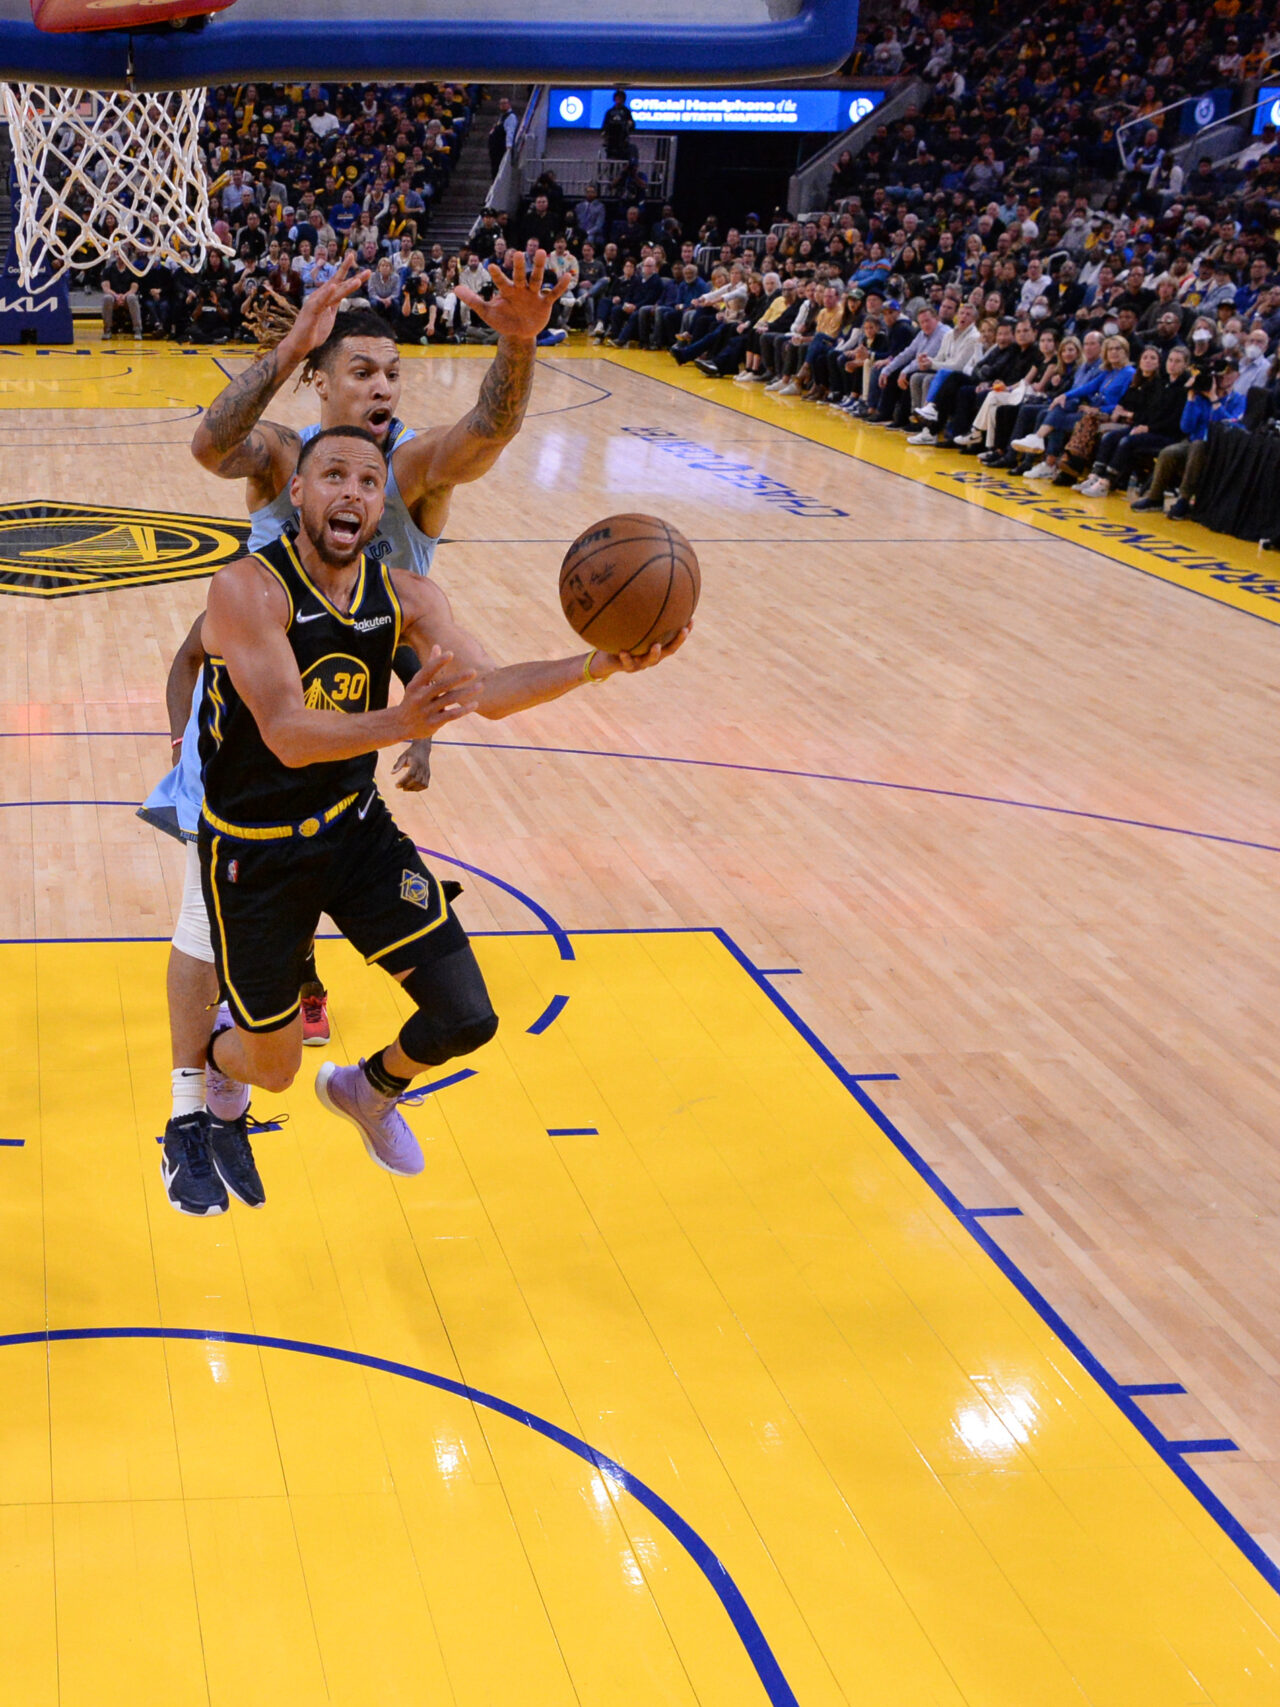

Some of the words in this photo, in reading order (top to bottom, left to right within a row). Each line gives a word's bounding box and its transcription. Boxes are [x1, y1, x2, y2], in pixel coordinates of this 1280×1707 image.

[629, 98, 686, 111] Official
[686, 99, 776, 112] Headphone
[681, 111, 723, 122] STATE
[723, 111, 799, 123] WARRIORS
[713, 473, 851, 517] CHASE
[353, 614, 393, 633] Rakuten
[331, 672, 366, 701] 30
